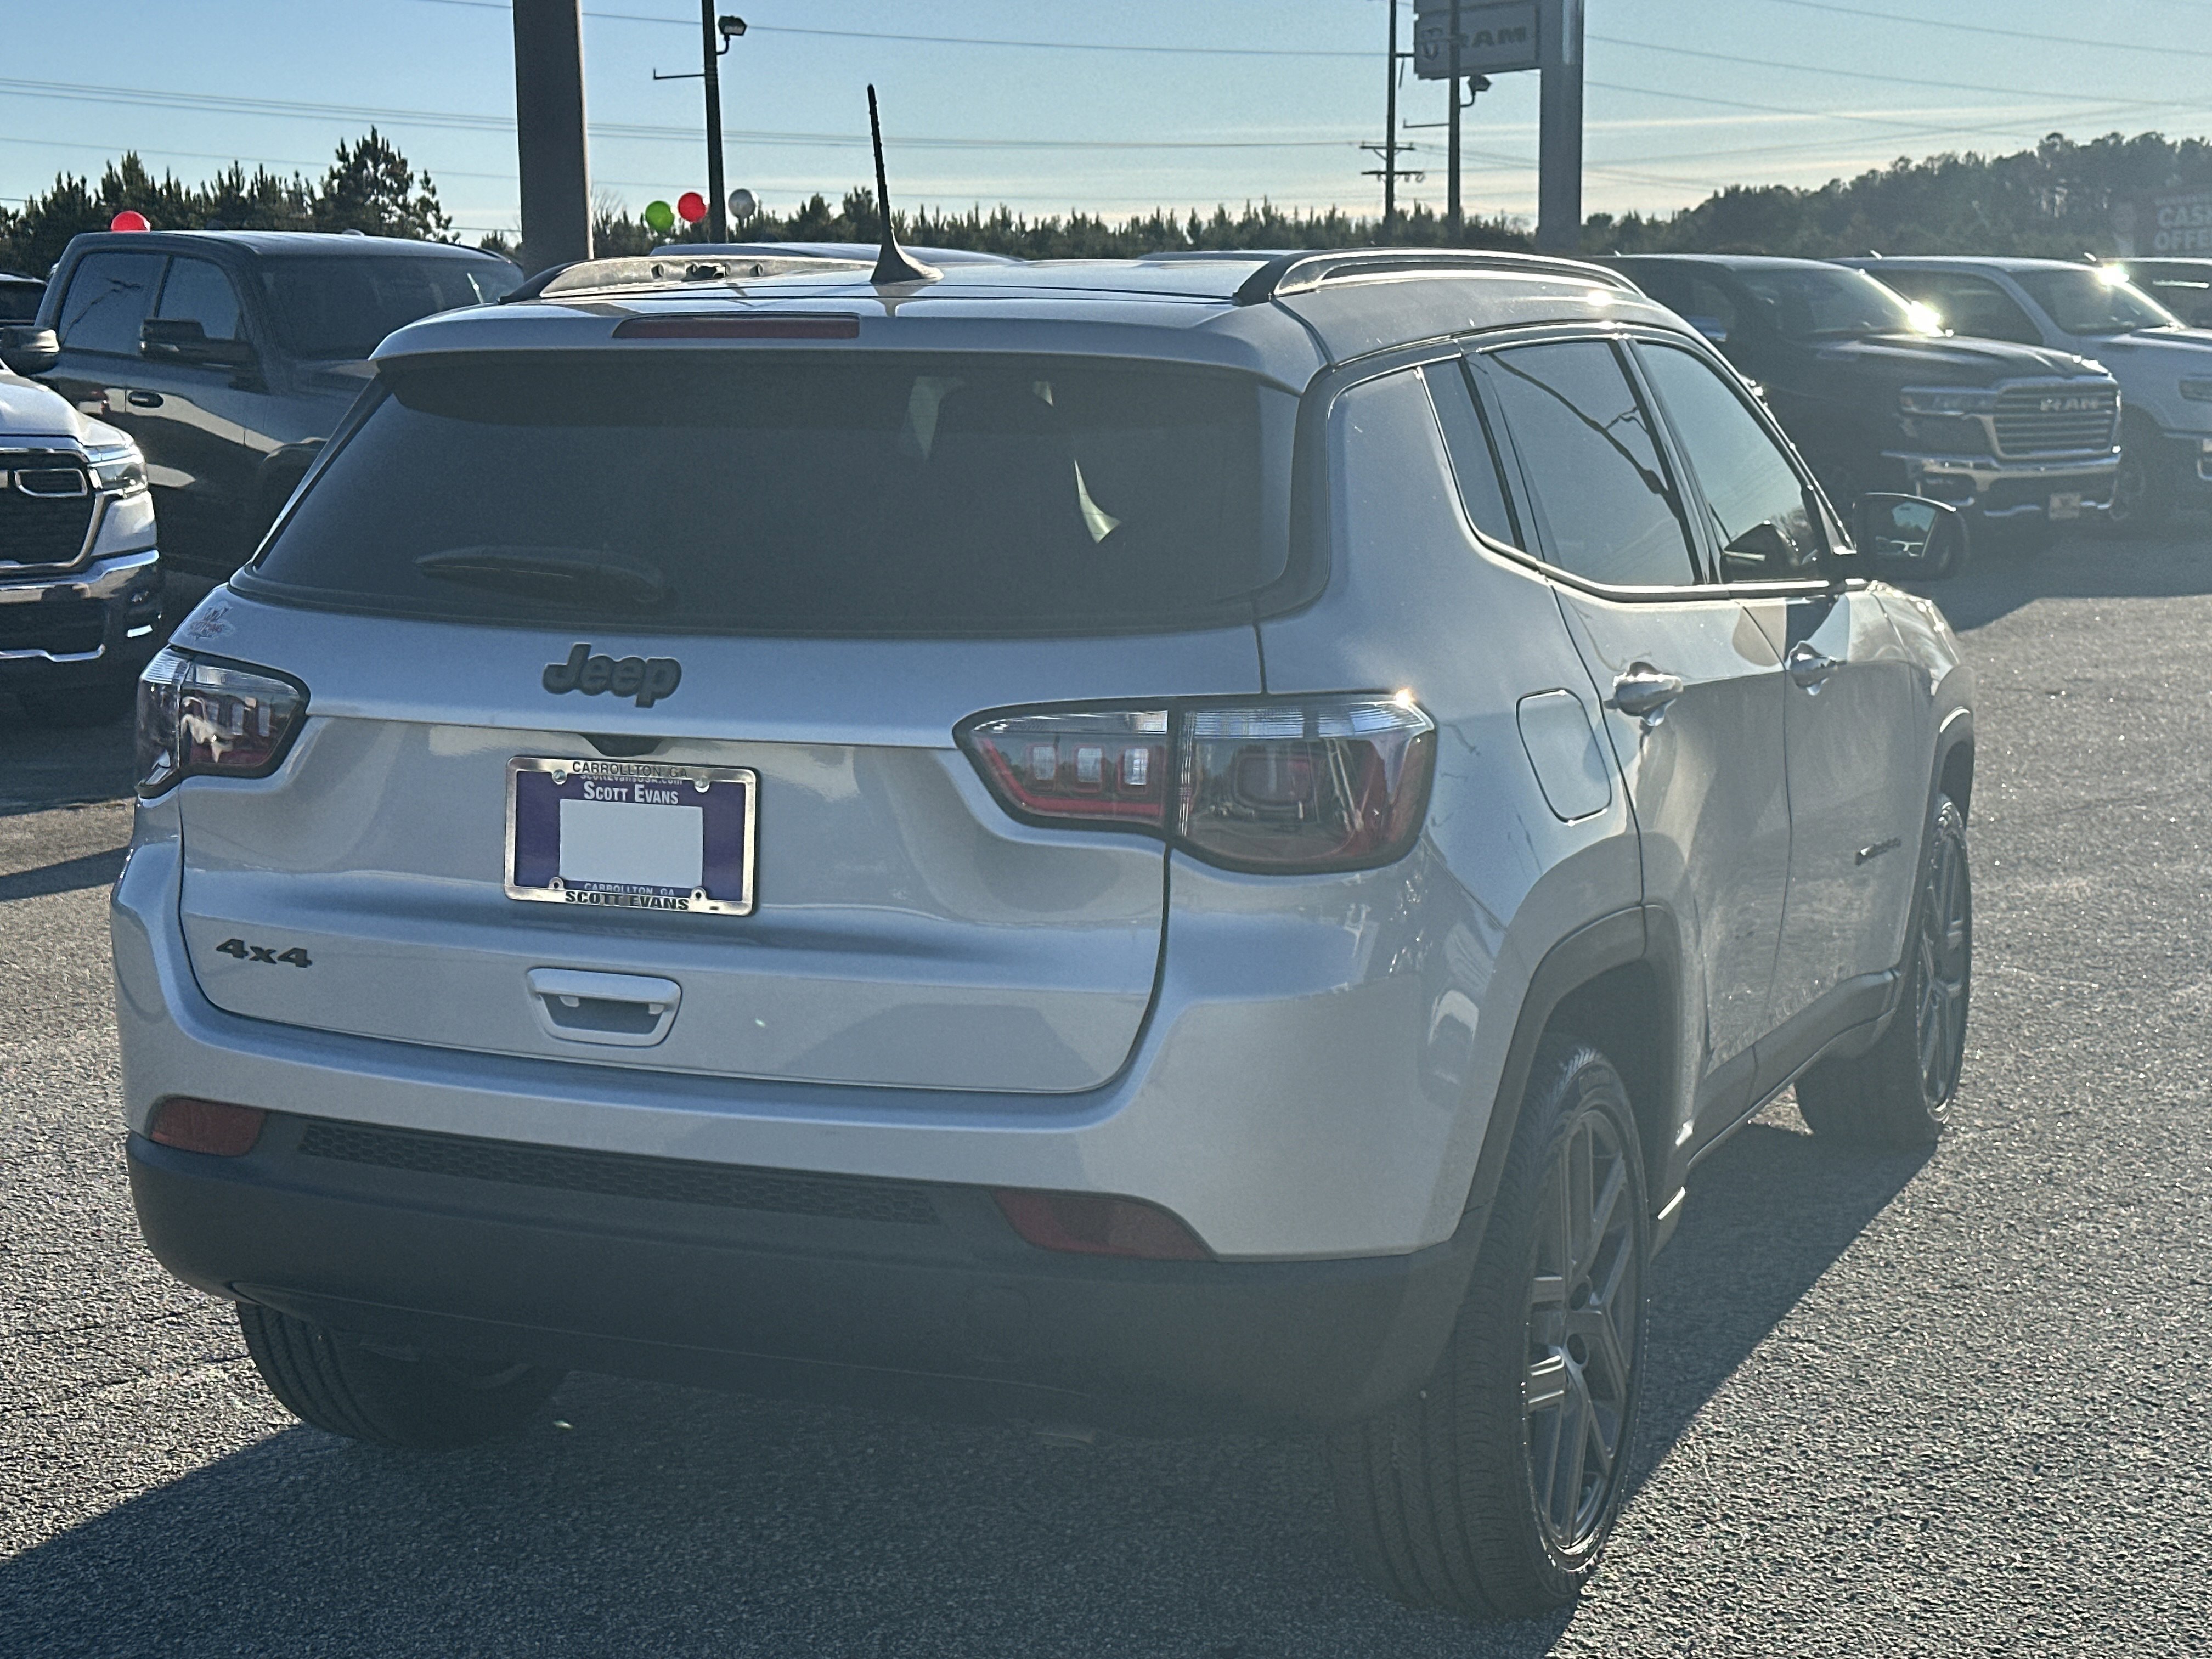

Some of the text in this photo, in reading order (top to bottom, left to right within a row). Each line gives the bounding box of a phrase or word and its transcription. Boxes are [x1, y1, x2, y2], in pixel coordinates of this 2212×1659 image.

[2040, 398, 2099, 411] RAM
[542, 642, 682, 708] Jeep
[669, 766, 688, 778] GA
[565, 890, 690, 911] SCOTT EVANS
[660, 888, 675, 896] GA
[216, 939, 313, 968] 4x4
